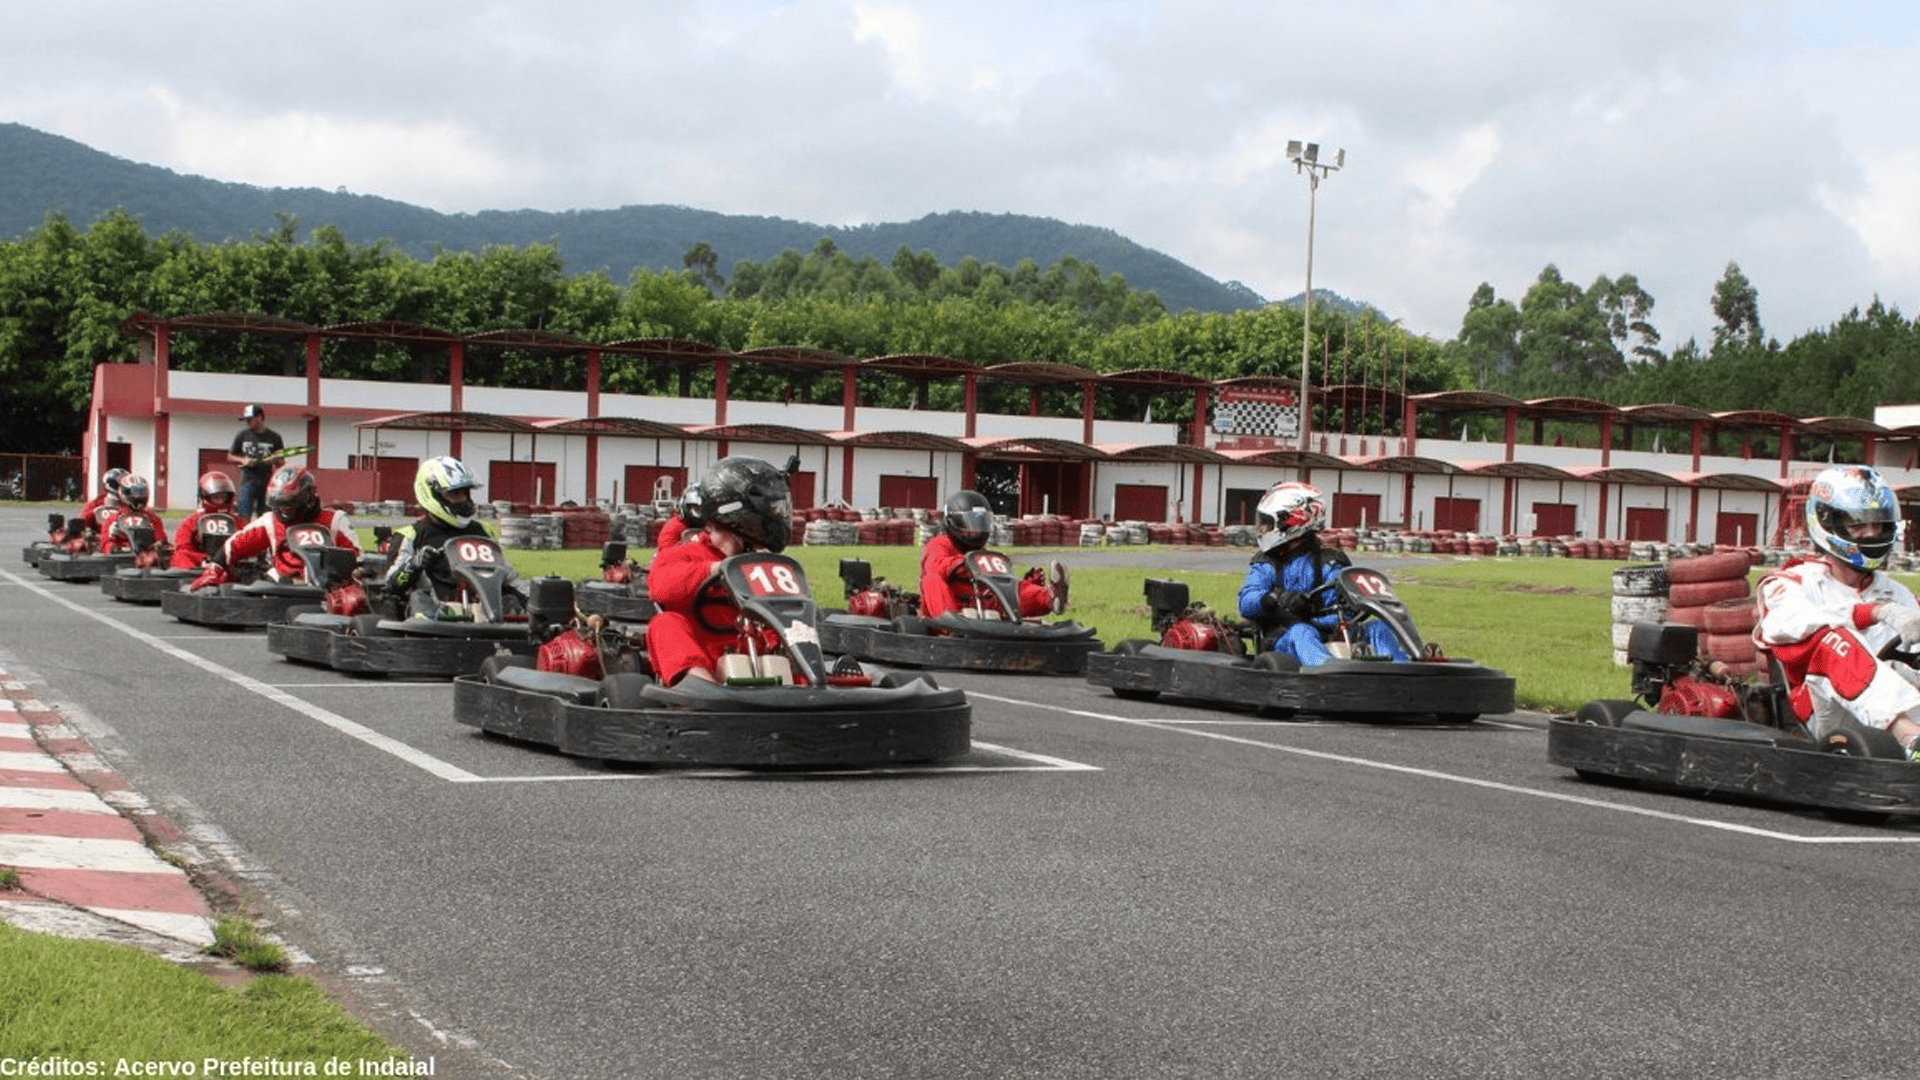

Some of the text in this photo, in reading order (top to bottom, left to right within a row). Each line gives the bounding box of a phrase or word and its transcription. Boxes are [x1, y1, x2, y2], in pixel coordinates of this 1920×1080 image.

[206, 520, 228, 533] 05
[297, 530, 325, 545] 20
[460, 542, 495, 563] 08
[977, 555, 1008, 574] 16
[748, 564, 801, 595] 18
[1355, 574, 1393, 598] 12
